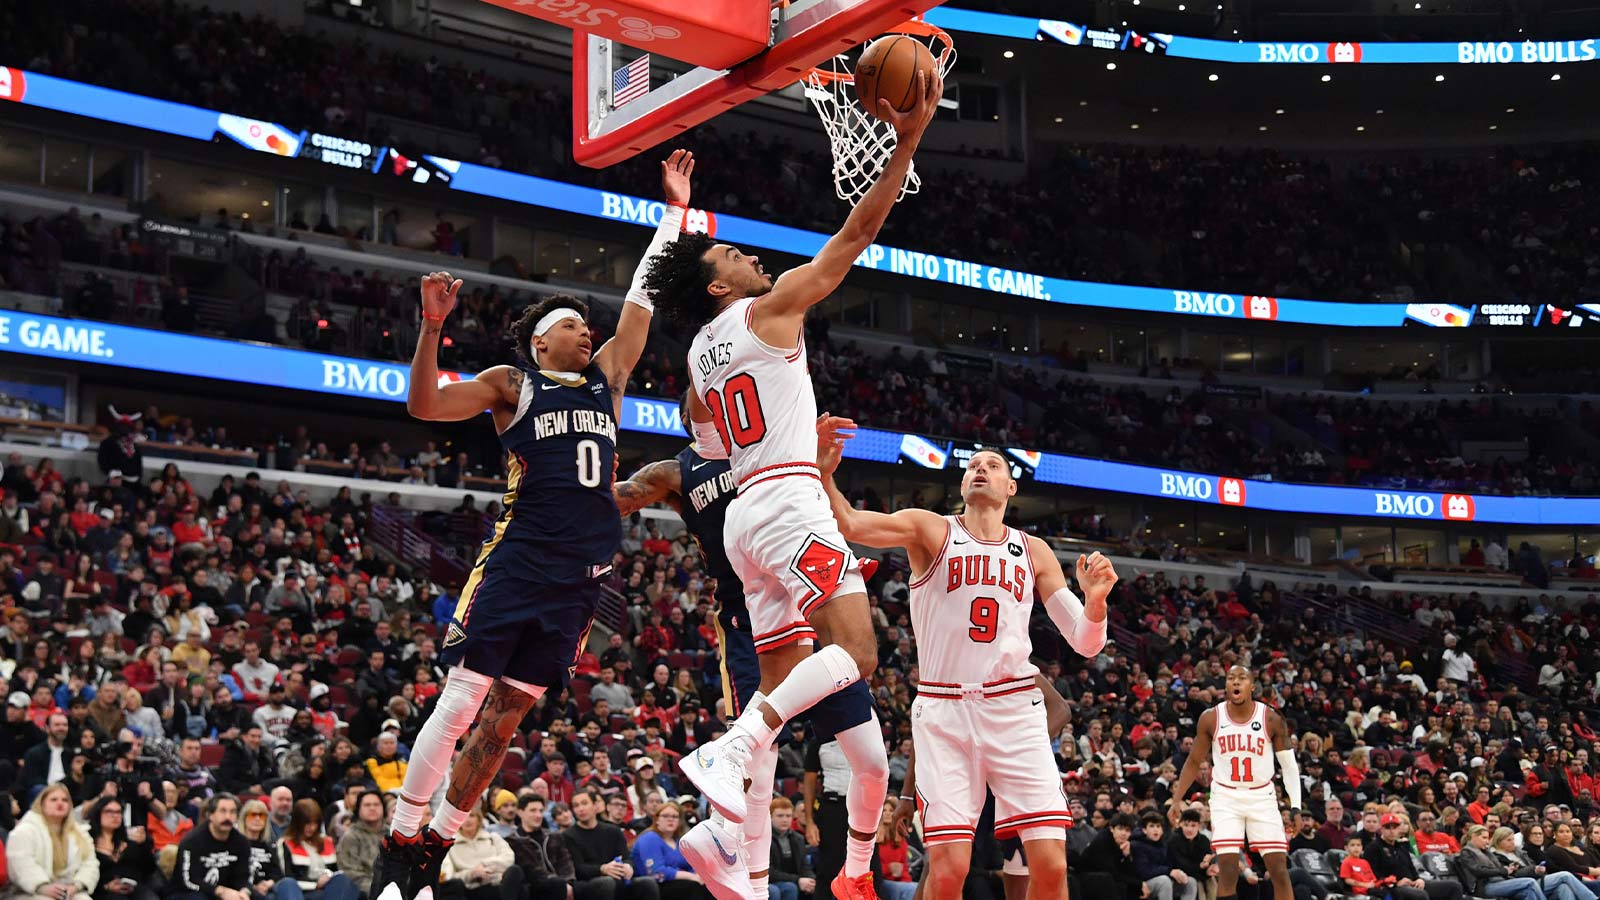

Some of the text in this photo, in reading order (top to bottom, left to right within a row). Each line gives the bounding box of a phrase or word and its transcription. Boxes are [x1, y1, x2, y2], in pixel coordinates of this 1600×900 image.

[1258, 43, 1320, 63] BMO
[1457, 39, 1597, 63] BMO BULLS
[311, 133, 372, 157] CHICAGO
[321, 149, 363, 169] BULLS
[601, 191, 668, 227] BMO
[852, 244, 1051, 301] AP INTO THE GAME.
[1173, 290, 1236, 316] BMO
[1480, 304, 1531, 315] CHICAGO
[1489, 315, 1524, 326] BULLS
[18, 319, 115, 359] GAME.
[697, 342, 733, 383] JONES
[322, 360, 406, 397] BMO
[533, 410, 569, 441] NEW
[634, 401, 681, 431] BM
[575, 439, 602, 488] 0
[688, 476, 719, 514] NEW
[1160, 472, 1212, 500] BMO
[1375, 493, 1435, 516] BMO
[946, 554, 1027, 603] BULLS
[968, 596, 1000, 644] 9
[1217, 733, 1266, 757] BULLS
[1230, 756, 1254, 782] 11
